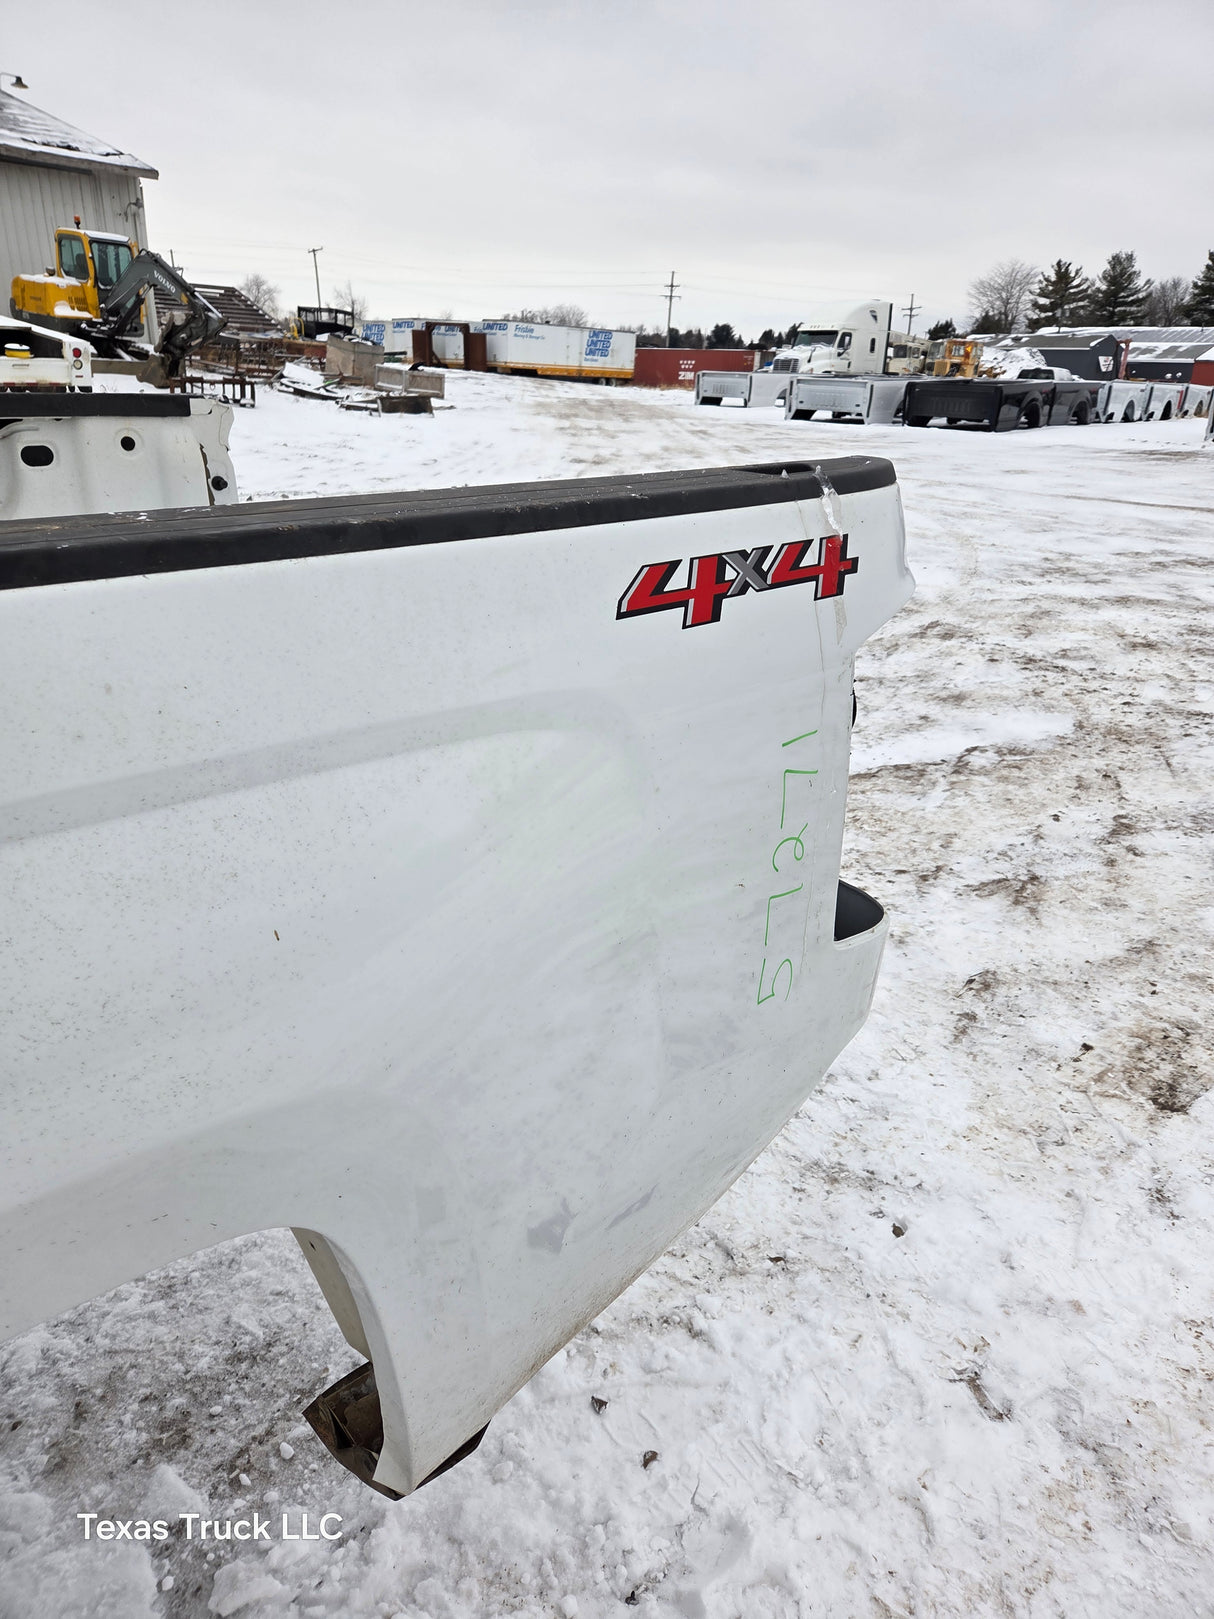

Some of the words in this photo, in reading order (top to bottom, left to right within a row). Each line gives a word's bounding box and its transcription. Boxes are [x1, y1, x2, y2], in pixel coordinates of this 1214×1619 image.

[153, 270, 176, 293] VOLVO
[362, 323, 386, 333] UNITED
[392, 320, 415, 329] UNITED
[482, 322, 508, 331] UNITED
[589, 330, 613, 340] UNITED
[587, 339, 611, 349] UNITED
[585, 347, 609, 357] UNITED
[678, 371, 694, 380] ZIM
